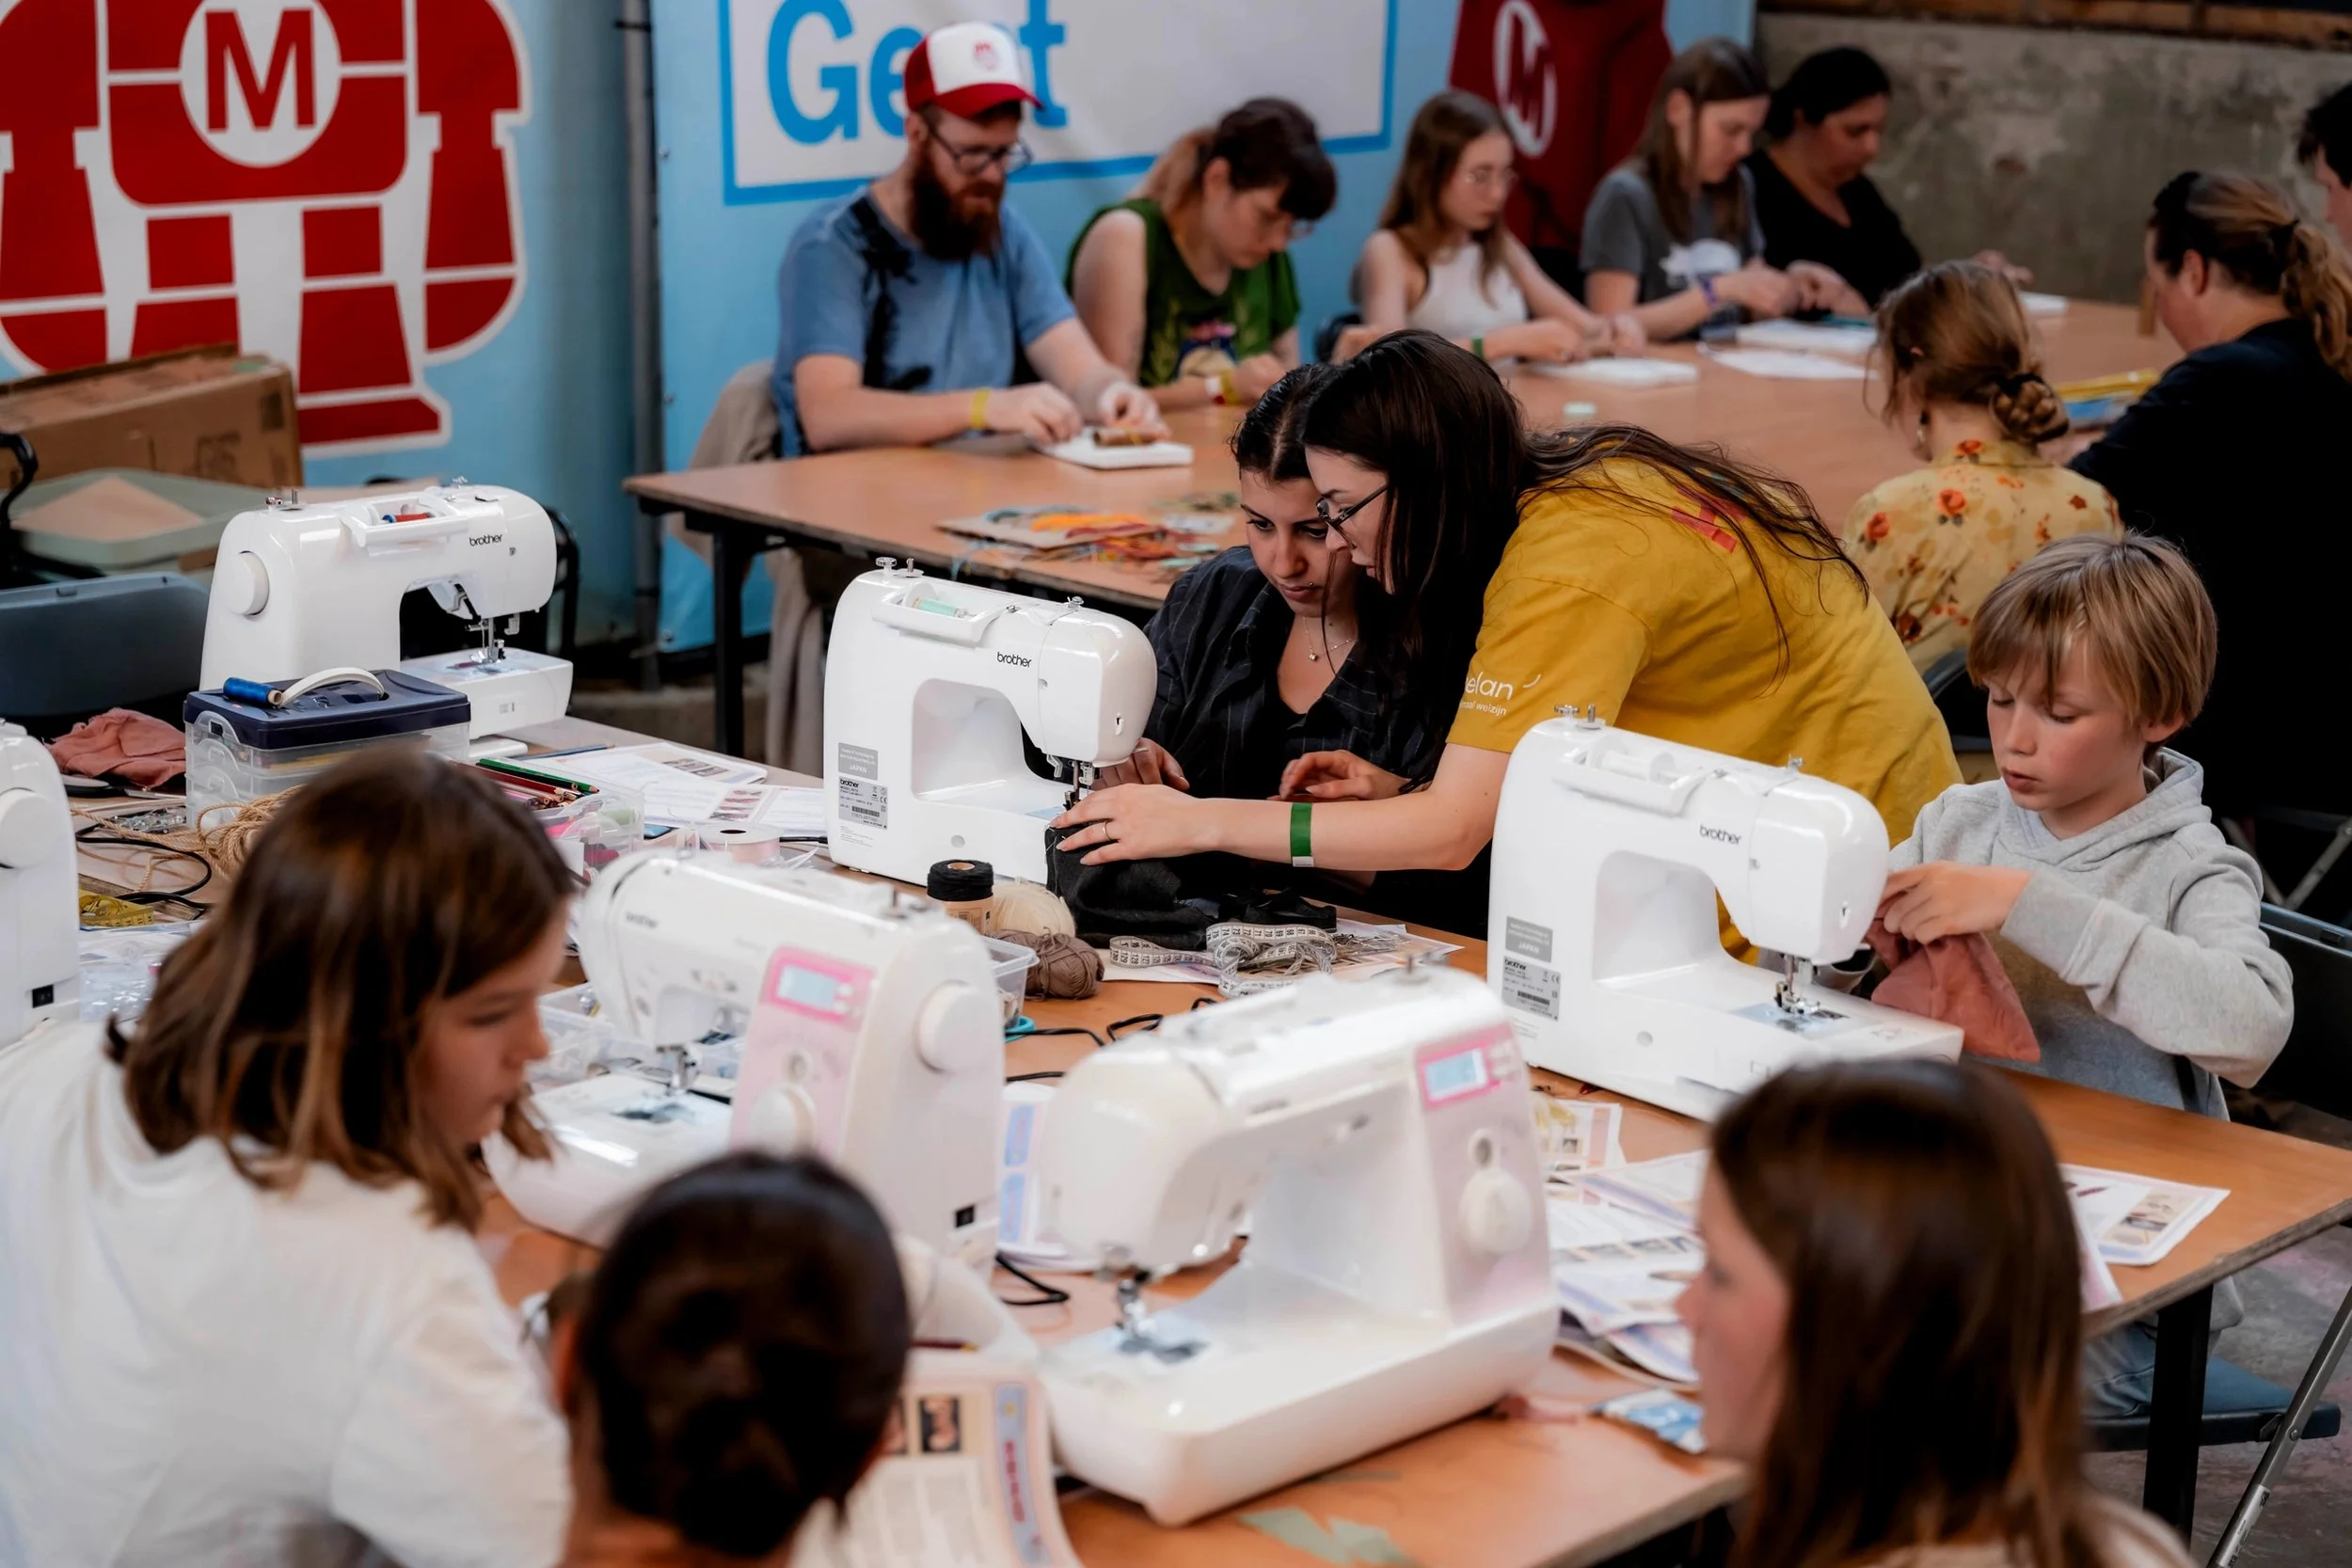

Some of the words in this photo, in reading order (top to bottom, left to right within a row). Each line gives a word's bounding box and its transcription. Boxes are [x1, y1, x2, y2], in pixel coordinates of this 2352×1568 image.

[204, 9, 317, 133] M
[767, 0, 1067, 146] Get
[469, 533, 503, 547] brother
[996, 651, 1032, 668] brother
[1464, 671, 1514, 701] elan
[1476, 702, 1507, 717] welzijn
[840, 779, 859, 787] brother
[1699, 823, 1742, 846] brother
